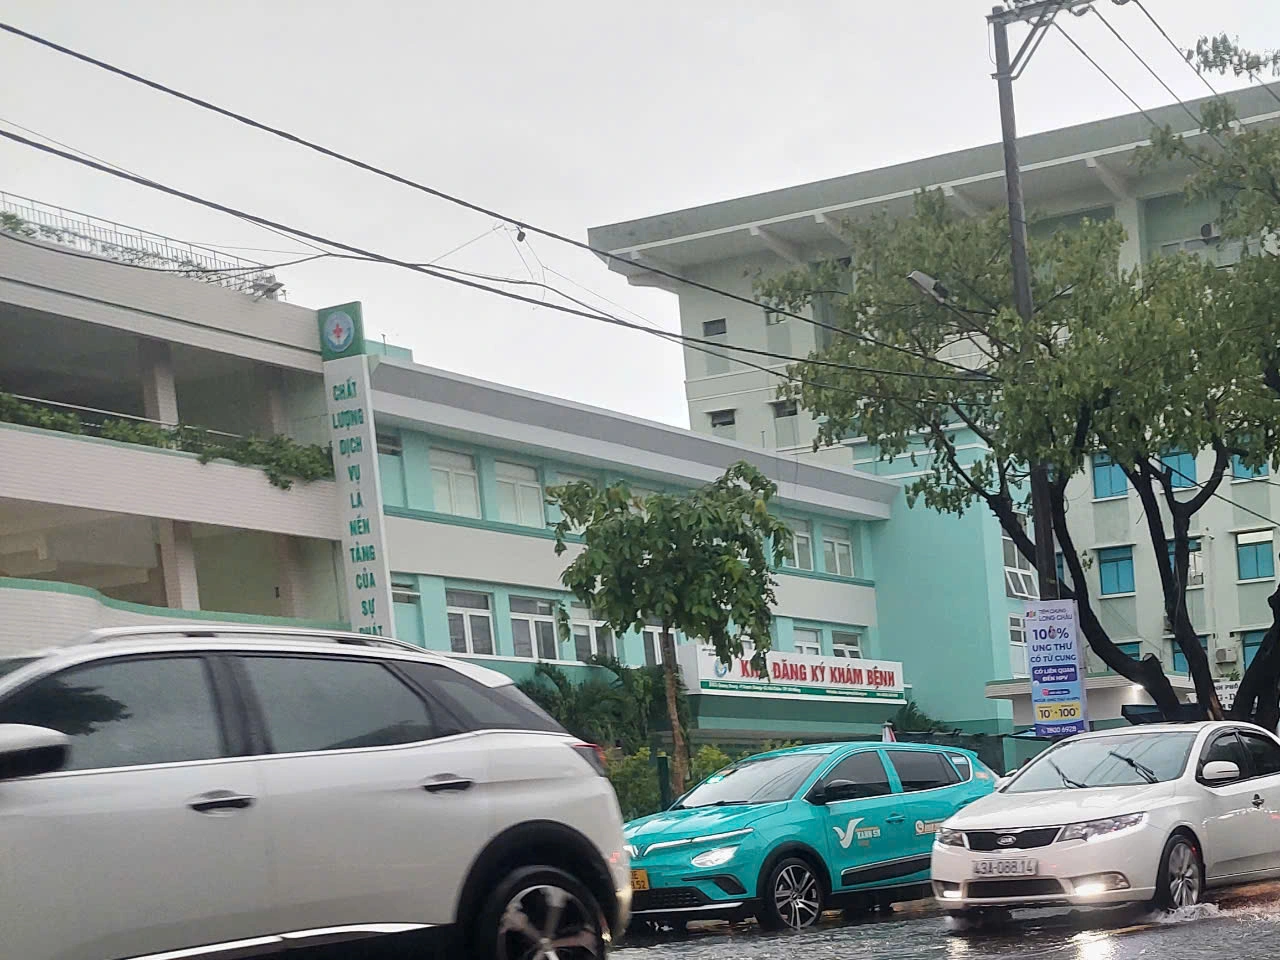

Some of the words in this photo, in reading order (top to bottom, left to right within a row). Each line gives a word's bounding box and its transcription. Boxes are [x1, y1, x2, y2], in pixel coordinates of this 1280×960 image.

[332, 408, 364, 430] LƯỢNG
[339, 436, 363, 457] DỊCH
[347, 464, 361, 485] VỤ
[355, 567, 376, 590] CỦA
[361, 598, 376, 619] SỰ
[1054, 653, 1077, 662] CUNG
[772, 659, 807, 682] ĐĂNG
[810, 661, 826, 683] KÝ
[829, 663, 864, 686] KHÁM
[866, 665, 896, 690] BỆNH
